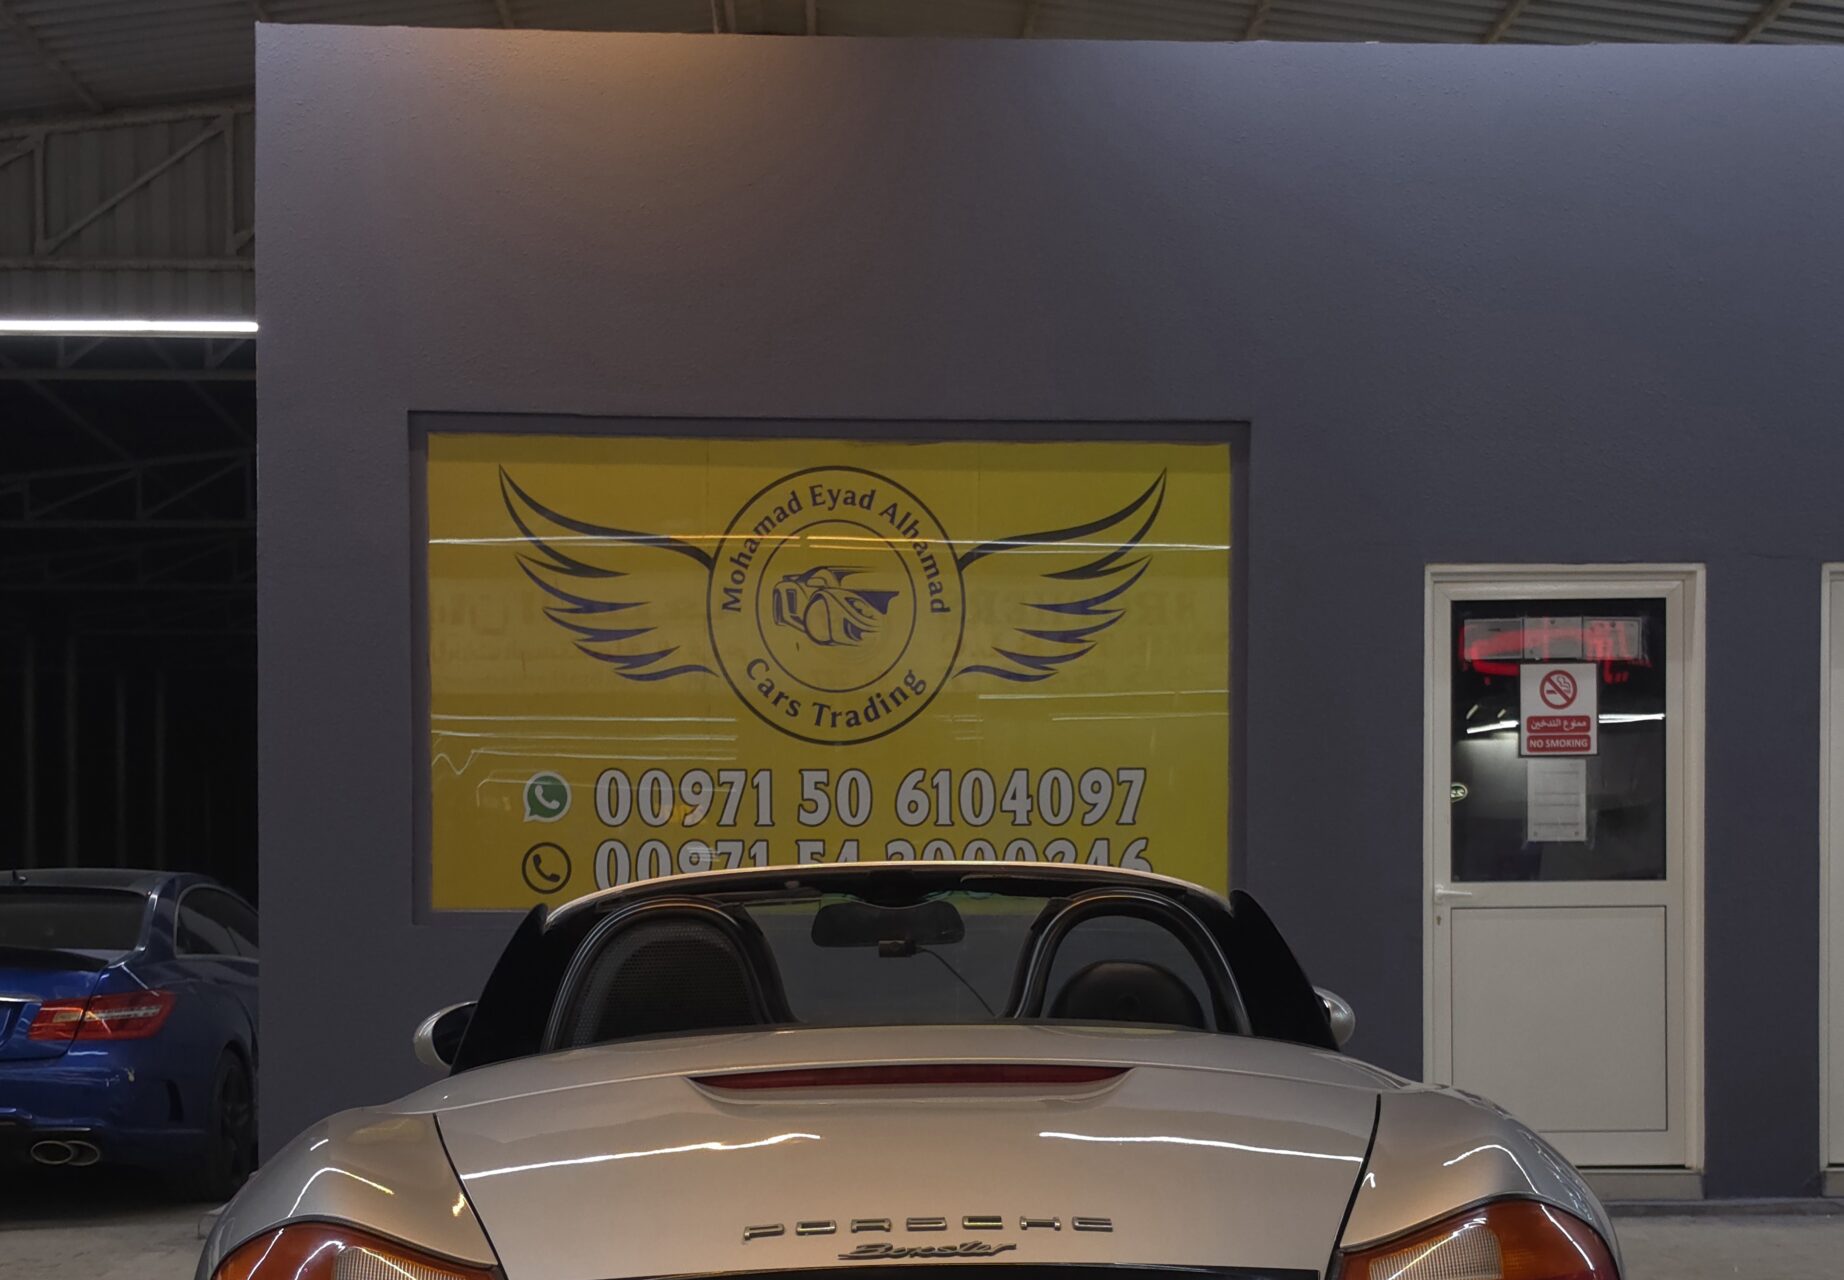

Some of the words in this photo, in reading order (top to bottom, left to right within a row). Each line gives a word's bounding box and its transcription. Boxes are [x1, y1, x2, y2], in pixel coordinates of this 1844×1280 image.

[721, 490, 803, 613] Mohamad
[809, 484, 876, 511] Eyad
[879, 502, 951, 613] Alhamad
[746, 658, 801, 717] Cars
[812, 669, 927, 728] Trading
[1529, 739, 1544, 748] NO
[1545, 739, 1588, 748] SMOKING
[594, 768, 774, 827] 00971
[797, 768, 873, 827] 50
[895, 768, 1147, 827] 6104097
[743, 1215, 1114, 1242] PORSCHE
